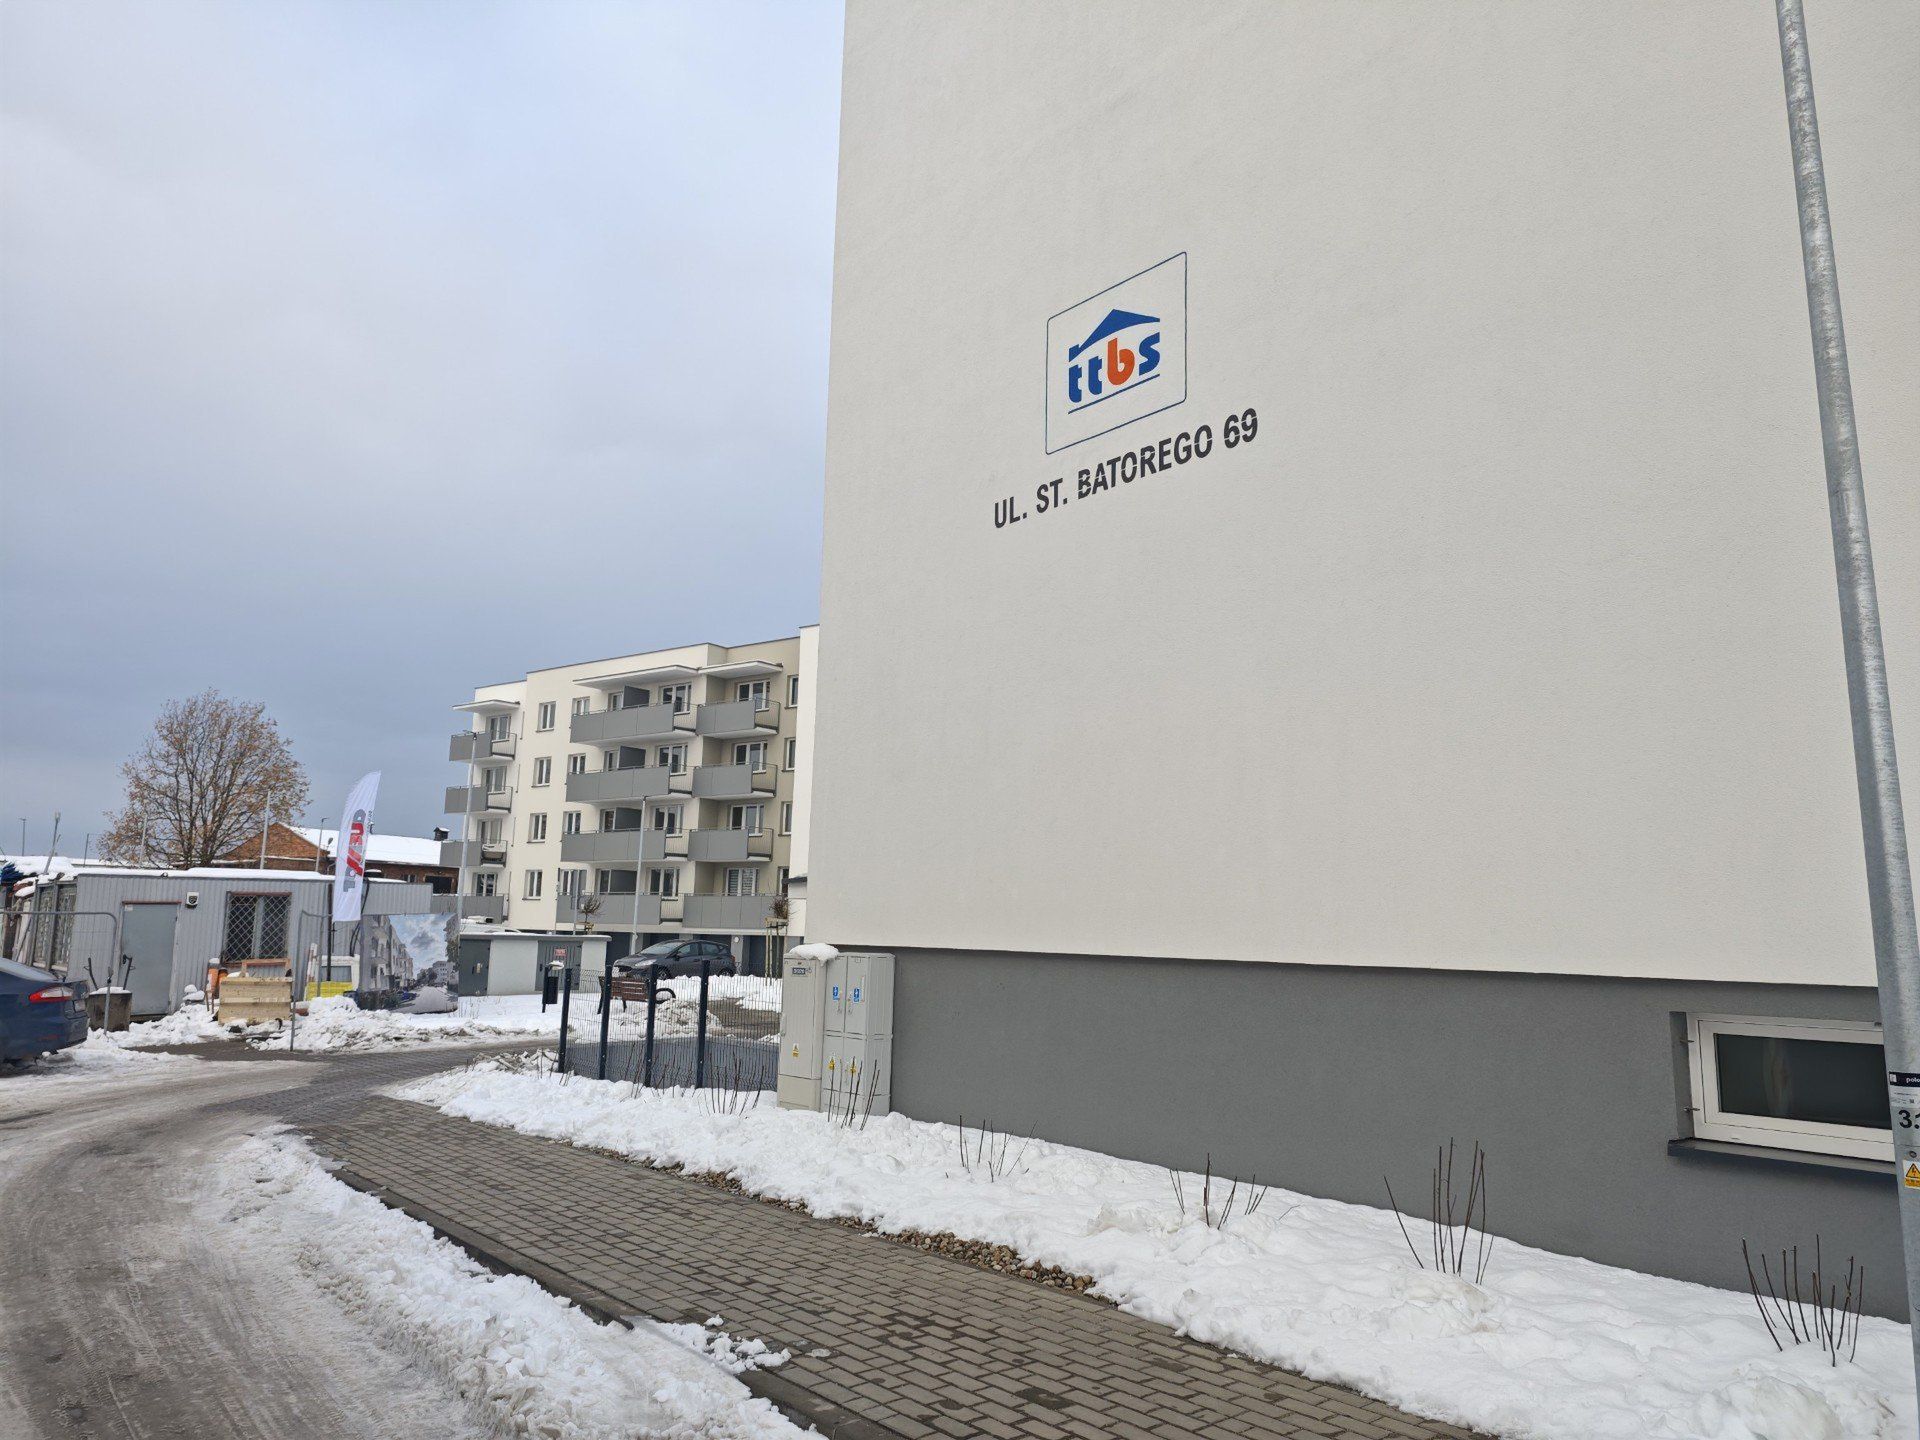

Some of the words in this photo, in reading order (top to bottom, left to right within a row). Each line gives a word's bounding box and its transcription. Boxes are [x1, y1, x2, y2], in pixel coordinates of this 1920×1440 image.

[1069, 332, 1160, 403] ttbs
[995, 497, 1027, 528] UL.
[1037, 477, 1068, 513] ST.
[1078, 425, 1213, 500] BATOREGO
[1224, 408, 1258, 449] 69
